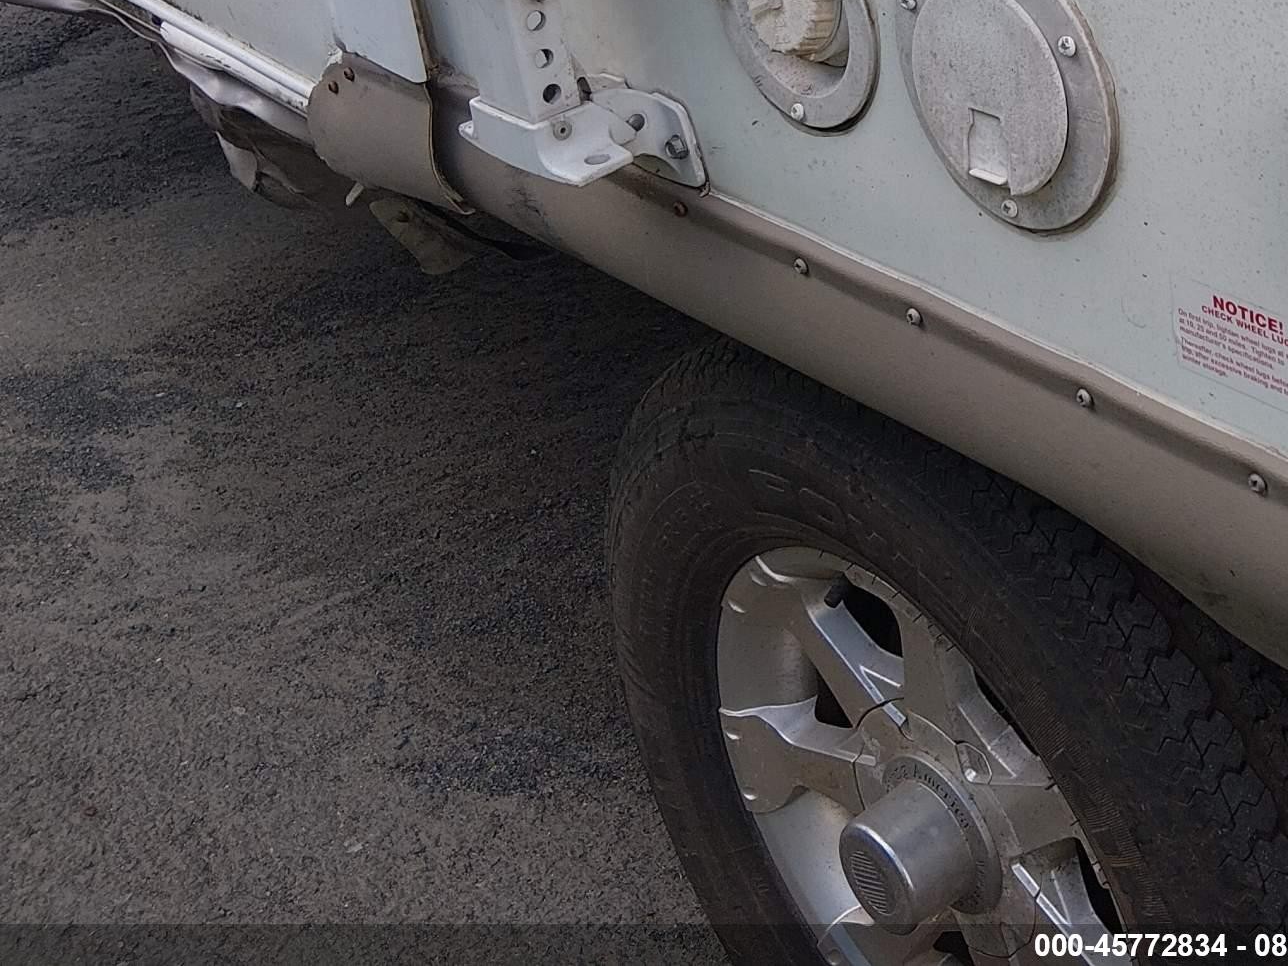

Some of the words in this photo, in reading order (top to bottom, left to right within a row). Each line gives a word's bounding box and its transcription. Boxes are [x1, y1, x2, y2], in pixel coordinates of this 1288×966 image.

[1178, 308, 1187, 317] On
[1241, 335, 1260, 347] wheel
[1262, 342, 1276, 355] lugs
[1202, 305, 1233, 325] CHECK
[1236, 320, 1269, 339] WHEEL
[1213, 295, 1285, 335] NOTICE!
[1206, 328, 1218, 338] and
[1251, 346, 1277, 363] Tighten
[1278, 357, 1285, 366] to
[1215, 351, 1234, 365] check
[1235, 360, 1255, 373] wheel
[1244, 372, 1268, 388] braking
[1270, 384, 1283, 394] and
